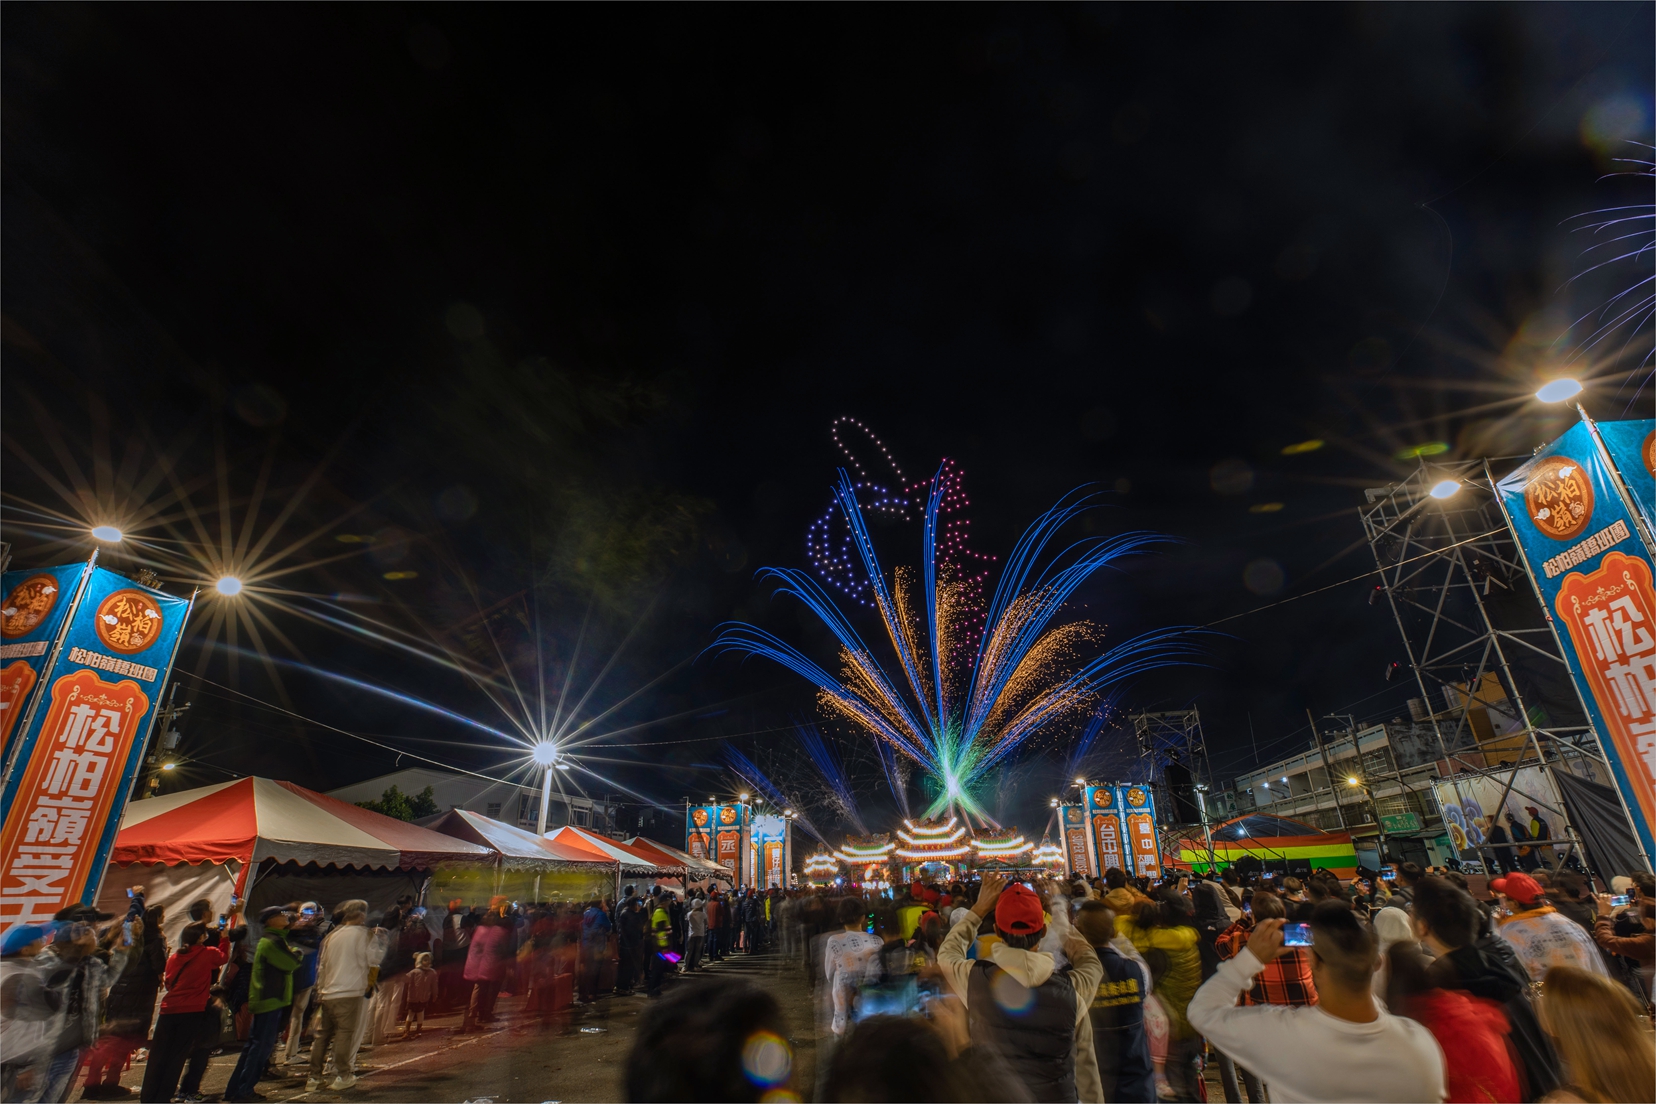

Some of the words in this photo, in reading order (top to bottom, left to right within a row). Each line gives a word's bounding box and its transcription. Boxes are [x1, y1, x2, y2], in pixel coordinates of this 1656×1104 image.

[1534, 475, 1582, 531] 松柏嶺
[109, 596, 152, 647] 松柏嶺
